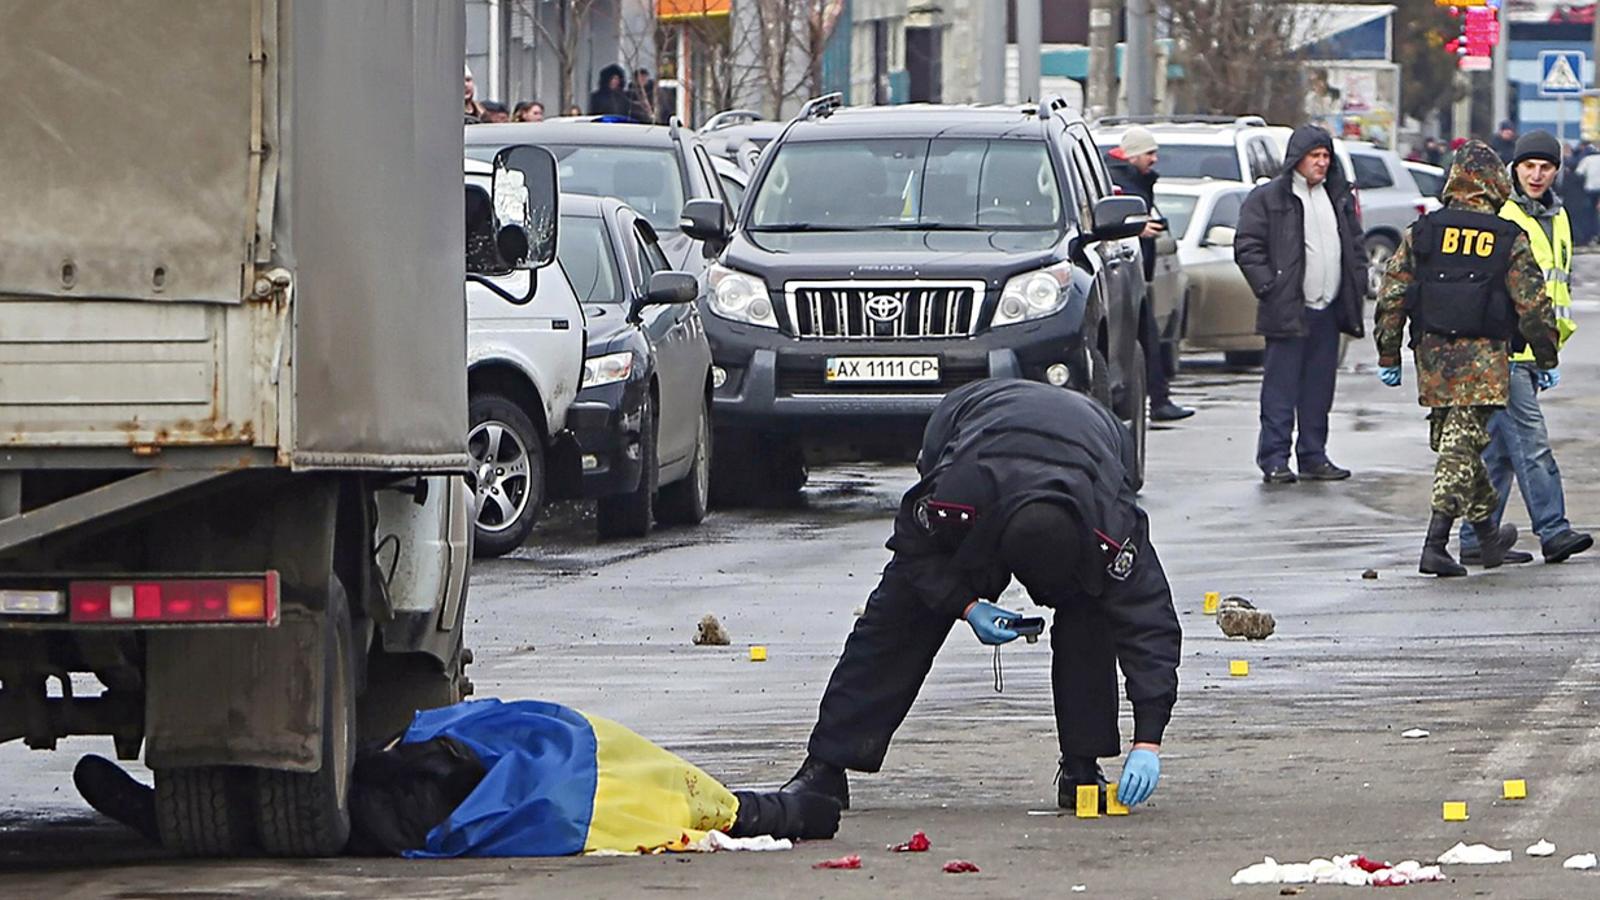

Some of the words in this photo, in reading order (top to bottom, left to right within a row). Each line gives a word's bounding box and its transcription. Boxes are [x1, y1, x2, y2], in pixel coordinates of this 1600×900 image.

[837, 361, 860, 377] AX
[867, 361, 904, 377] 1111
[909, 360, 933, 377] CP
